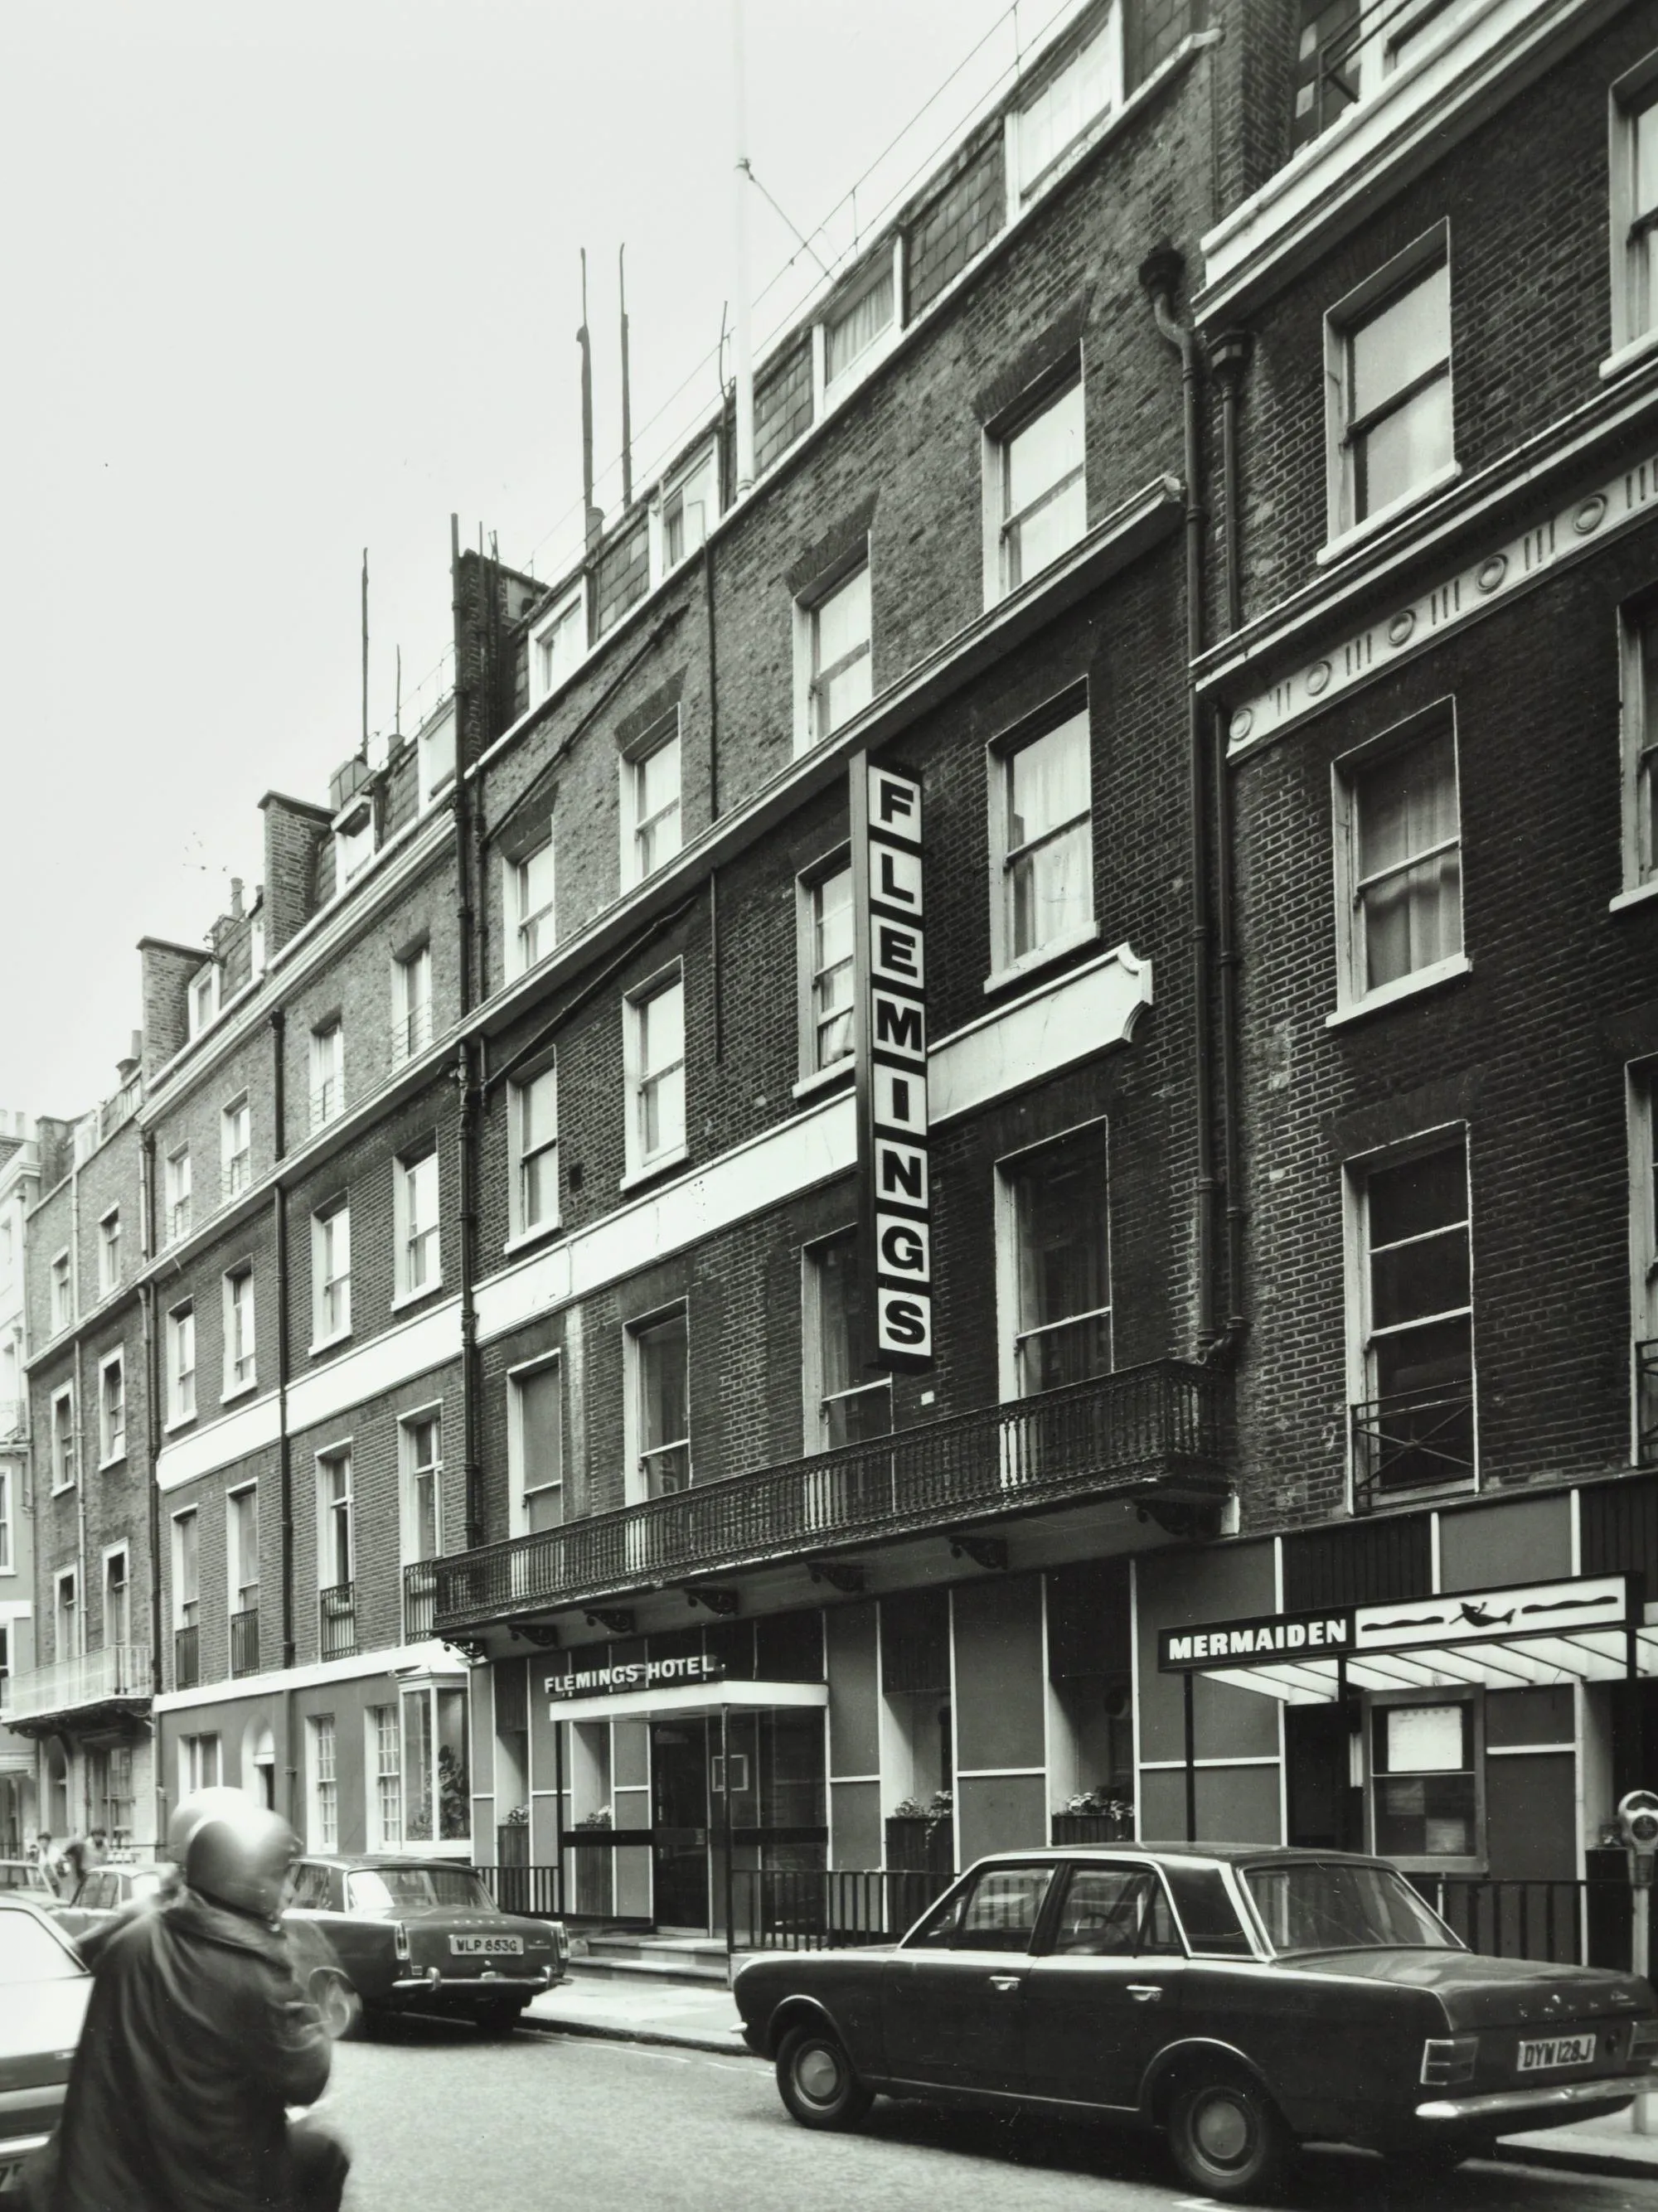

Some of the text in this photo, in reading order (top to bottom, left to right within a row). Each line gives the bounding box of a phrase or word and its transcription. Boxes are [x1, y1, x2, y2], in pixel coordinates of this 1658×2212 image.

[876, 778, 926, 1345] FLEMINGS
[1169, 1619, 1346, 1661] MERMAIDEN
[544, 1654, 715, 1694] FLEMINGS HOTEL
